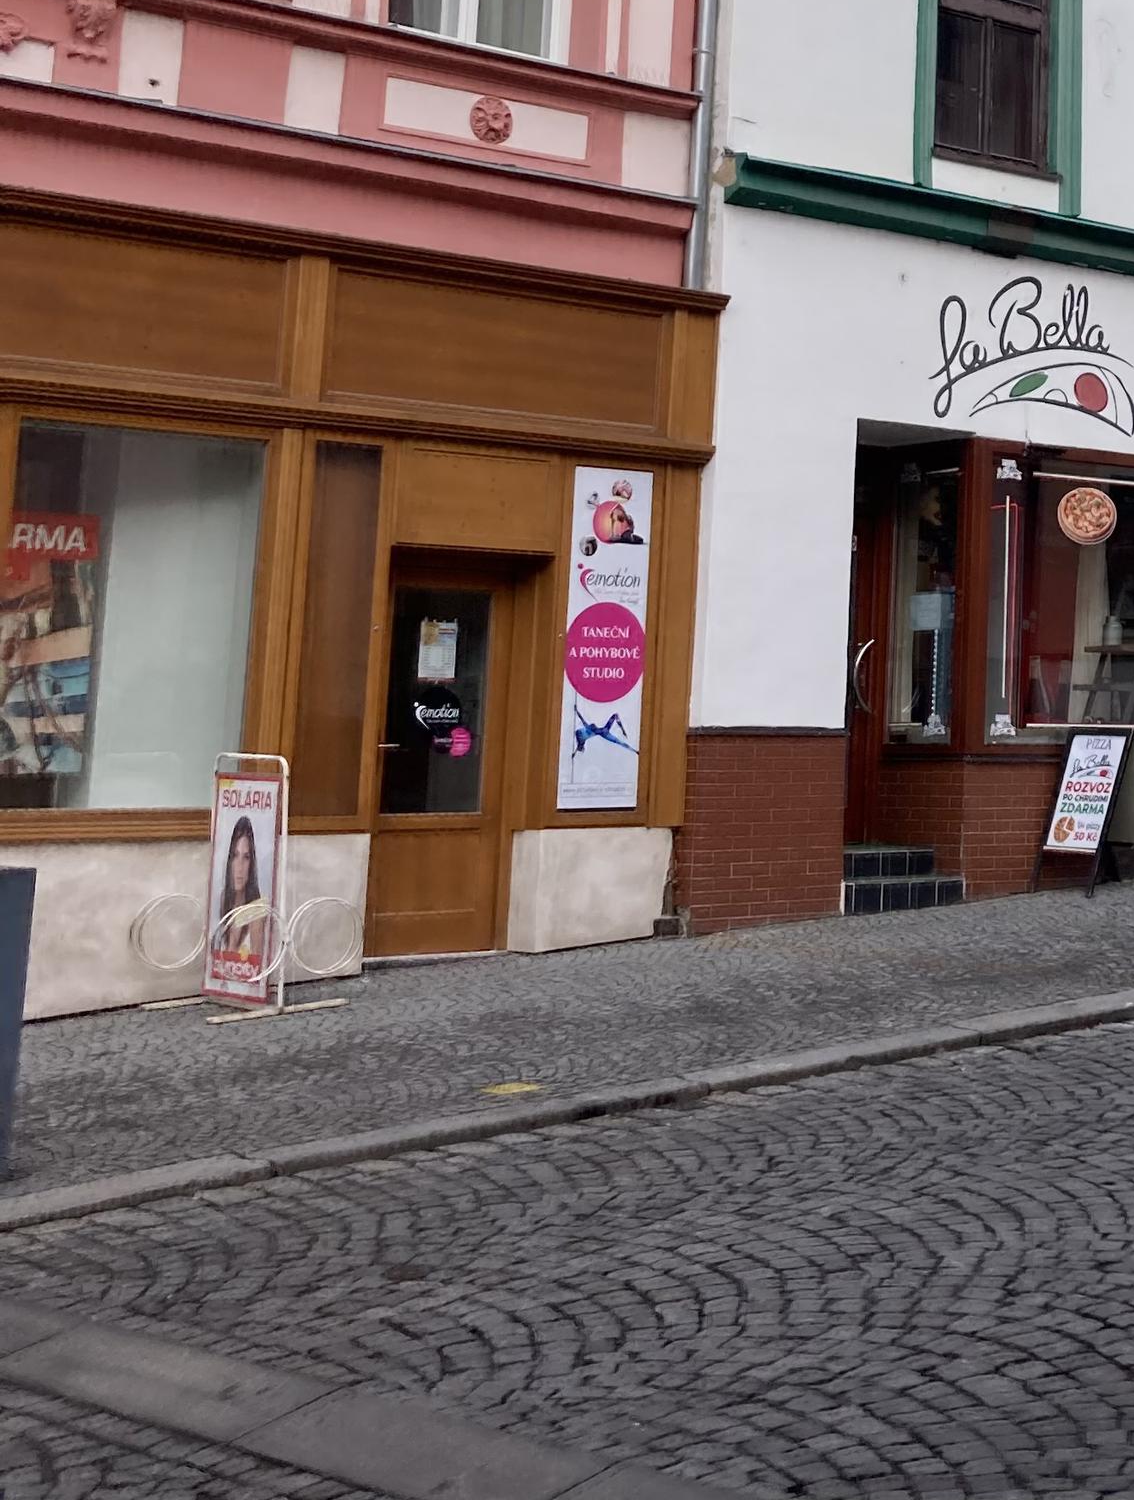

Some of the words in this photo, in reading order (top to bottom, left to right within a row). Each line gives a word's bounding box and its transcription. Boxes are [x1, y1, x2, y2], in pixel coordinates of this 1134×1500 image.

[989, 276, 1110, 357] Bella
[8, 522, 87, 552] RMA
[586, 567, 641, 588] emotion
[581, 625, 631, 639] TANEČNÍ
[569, 646, 577, 658] A
[579, 645, 641, 659] POHYBOVÉ
[582, 666, 625, 679] STUDIO
[1085, 739, 1112, 750] PIZZA
[1064, 781, 1112, 793] ROZVOZ
[1062, 793, 1073, 801] PO
[1059, 802, 1105, 815] ZDARMA
[1073, 831, 1085, 841] 50
